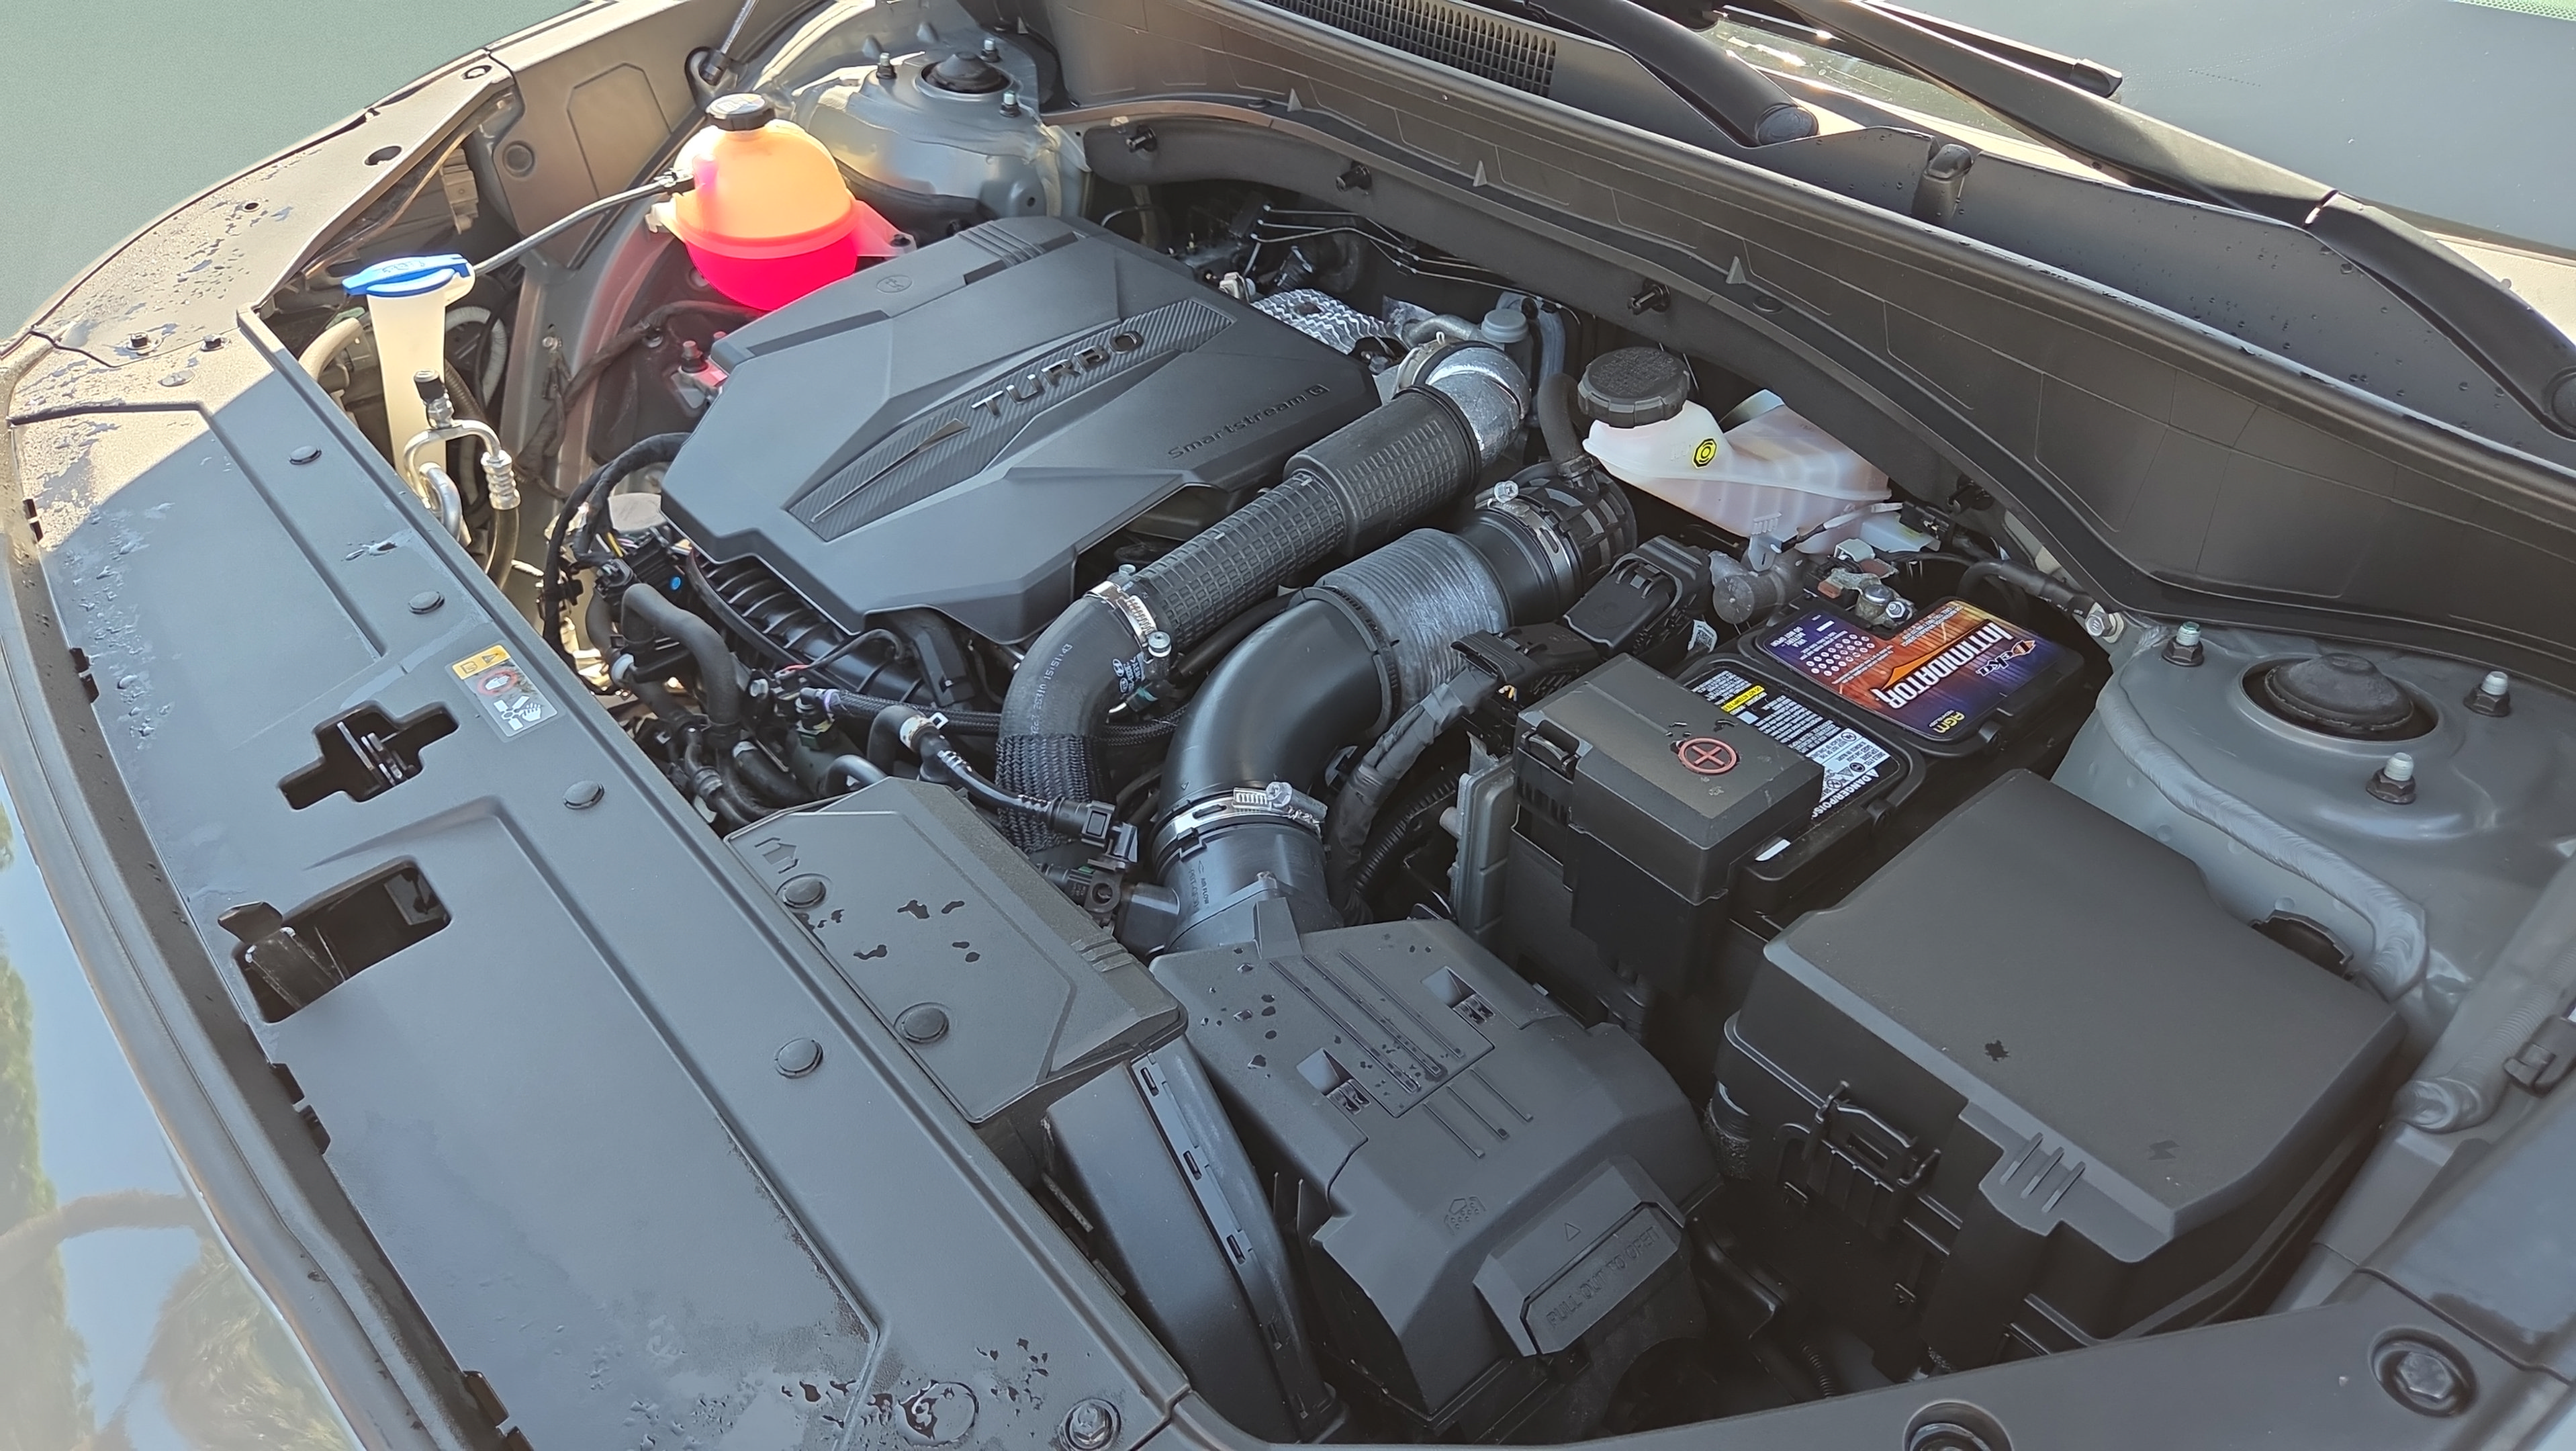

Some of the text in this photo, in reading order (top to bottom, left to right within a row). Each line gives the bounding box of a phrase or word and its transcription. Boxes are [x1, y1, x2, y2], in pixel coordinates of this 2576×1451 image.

[971, 330, 1143, 417] TURBO
[1168, 395, 1307, 459] Smartstream
[1044, 644, 1073, 680] 15:51:43
[1933, 711, 1966, 734] AGM
[1811, 775, 1872, 820] DANGER/POIS
[1545, 1225, 1660, 1328] PULL OUT TO OPEN
